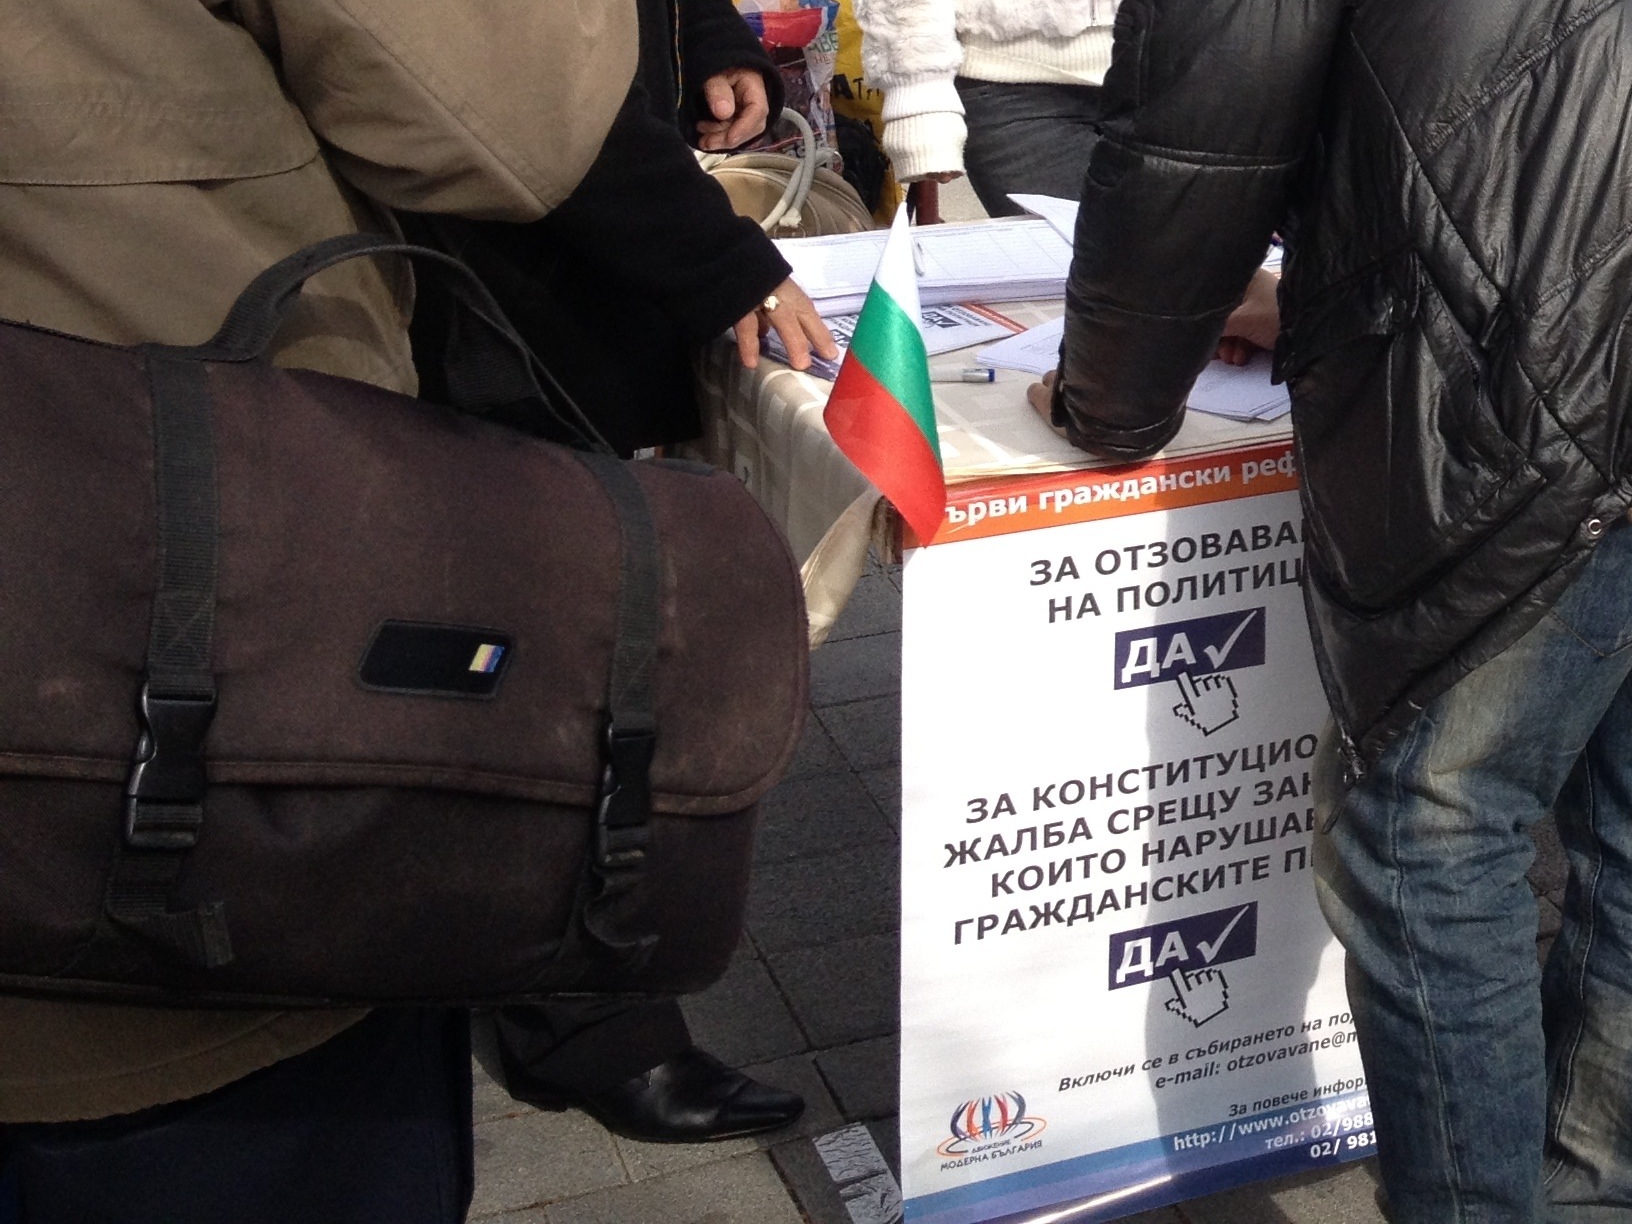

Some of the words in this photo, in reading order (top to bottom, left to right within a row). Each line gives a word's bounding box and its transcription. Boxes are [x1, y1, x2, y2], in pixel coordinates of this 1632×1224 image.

[945, 494, 1027, 526] ърви
[1038, 464, 1232, 513] граждански
[1029, 556, 1080, 587] ЗА
[1095, 520, 1302, 576] ОТЗОВАВА
[1049, 593, 1102, 624] НА
[1117, 557, 1301, 613] ПОЛИТИЦ
[1122, 632, 1197, 683] ДА
[966, 793, 1017, 823] ЗА
[1033, 733, 1318, 811] КОНСТИТУЦИО
[944, 817, 1093, 868] ЖАЛБА
[1107, 786, 1241, 834] СРЕЩУ
[955, 855, 1270, 945] ГРАЖДАНСКИТЕ
[992, 848, 1126, 898] КОИТО
[1116, 932, 1189, 983] ДА
[1059, 1064, 1136, 1091] Включи
[1141, 1058, 1163, 1071] се
[1168, 1054, 1179, 1066] в
[1185, 1025, 1295, 1062] събирането
[1300, 1018, 1322, 1033] на
[1155, 1061, 1221, 1090] e-mail:
[1227, 1030, 1358, 1073] otzovavane@m
[1173, 1095, 1370, 1151] http://www.otzovava
[1229, 1104, 1247, 1118] За
[1252, 1089, 1309, 1113] повече
[1312, 1076, 1367, 1101] инфор
[940, 1152, 989, 1171] МОДЕРНА
[992, 1140, 1042, 1159] БЪЛГАРИЯ
[1265, 1130, 1305, 1150] тел.:
[1310, 1137, 1341, 1158] 02/
[1347, 1131, 1377, 1150] 981
